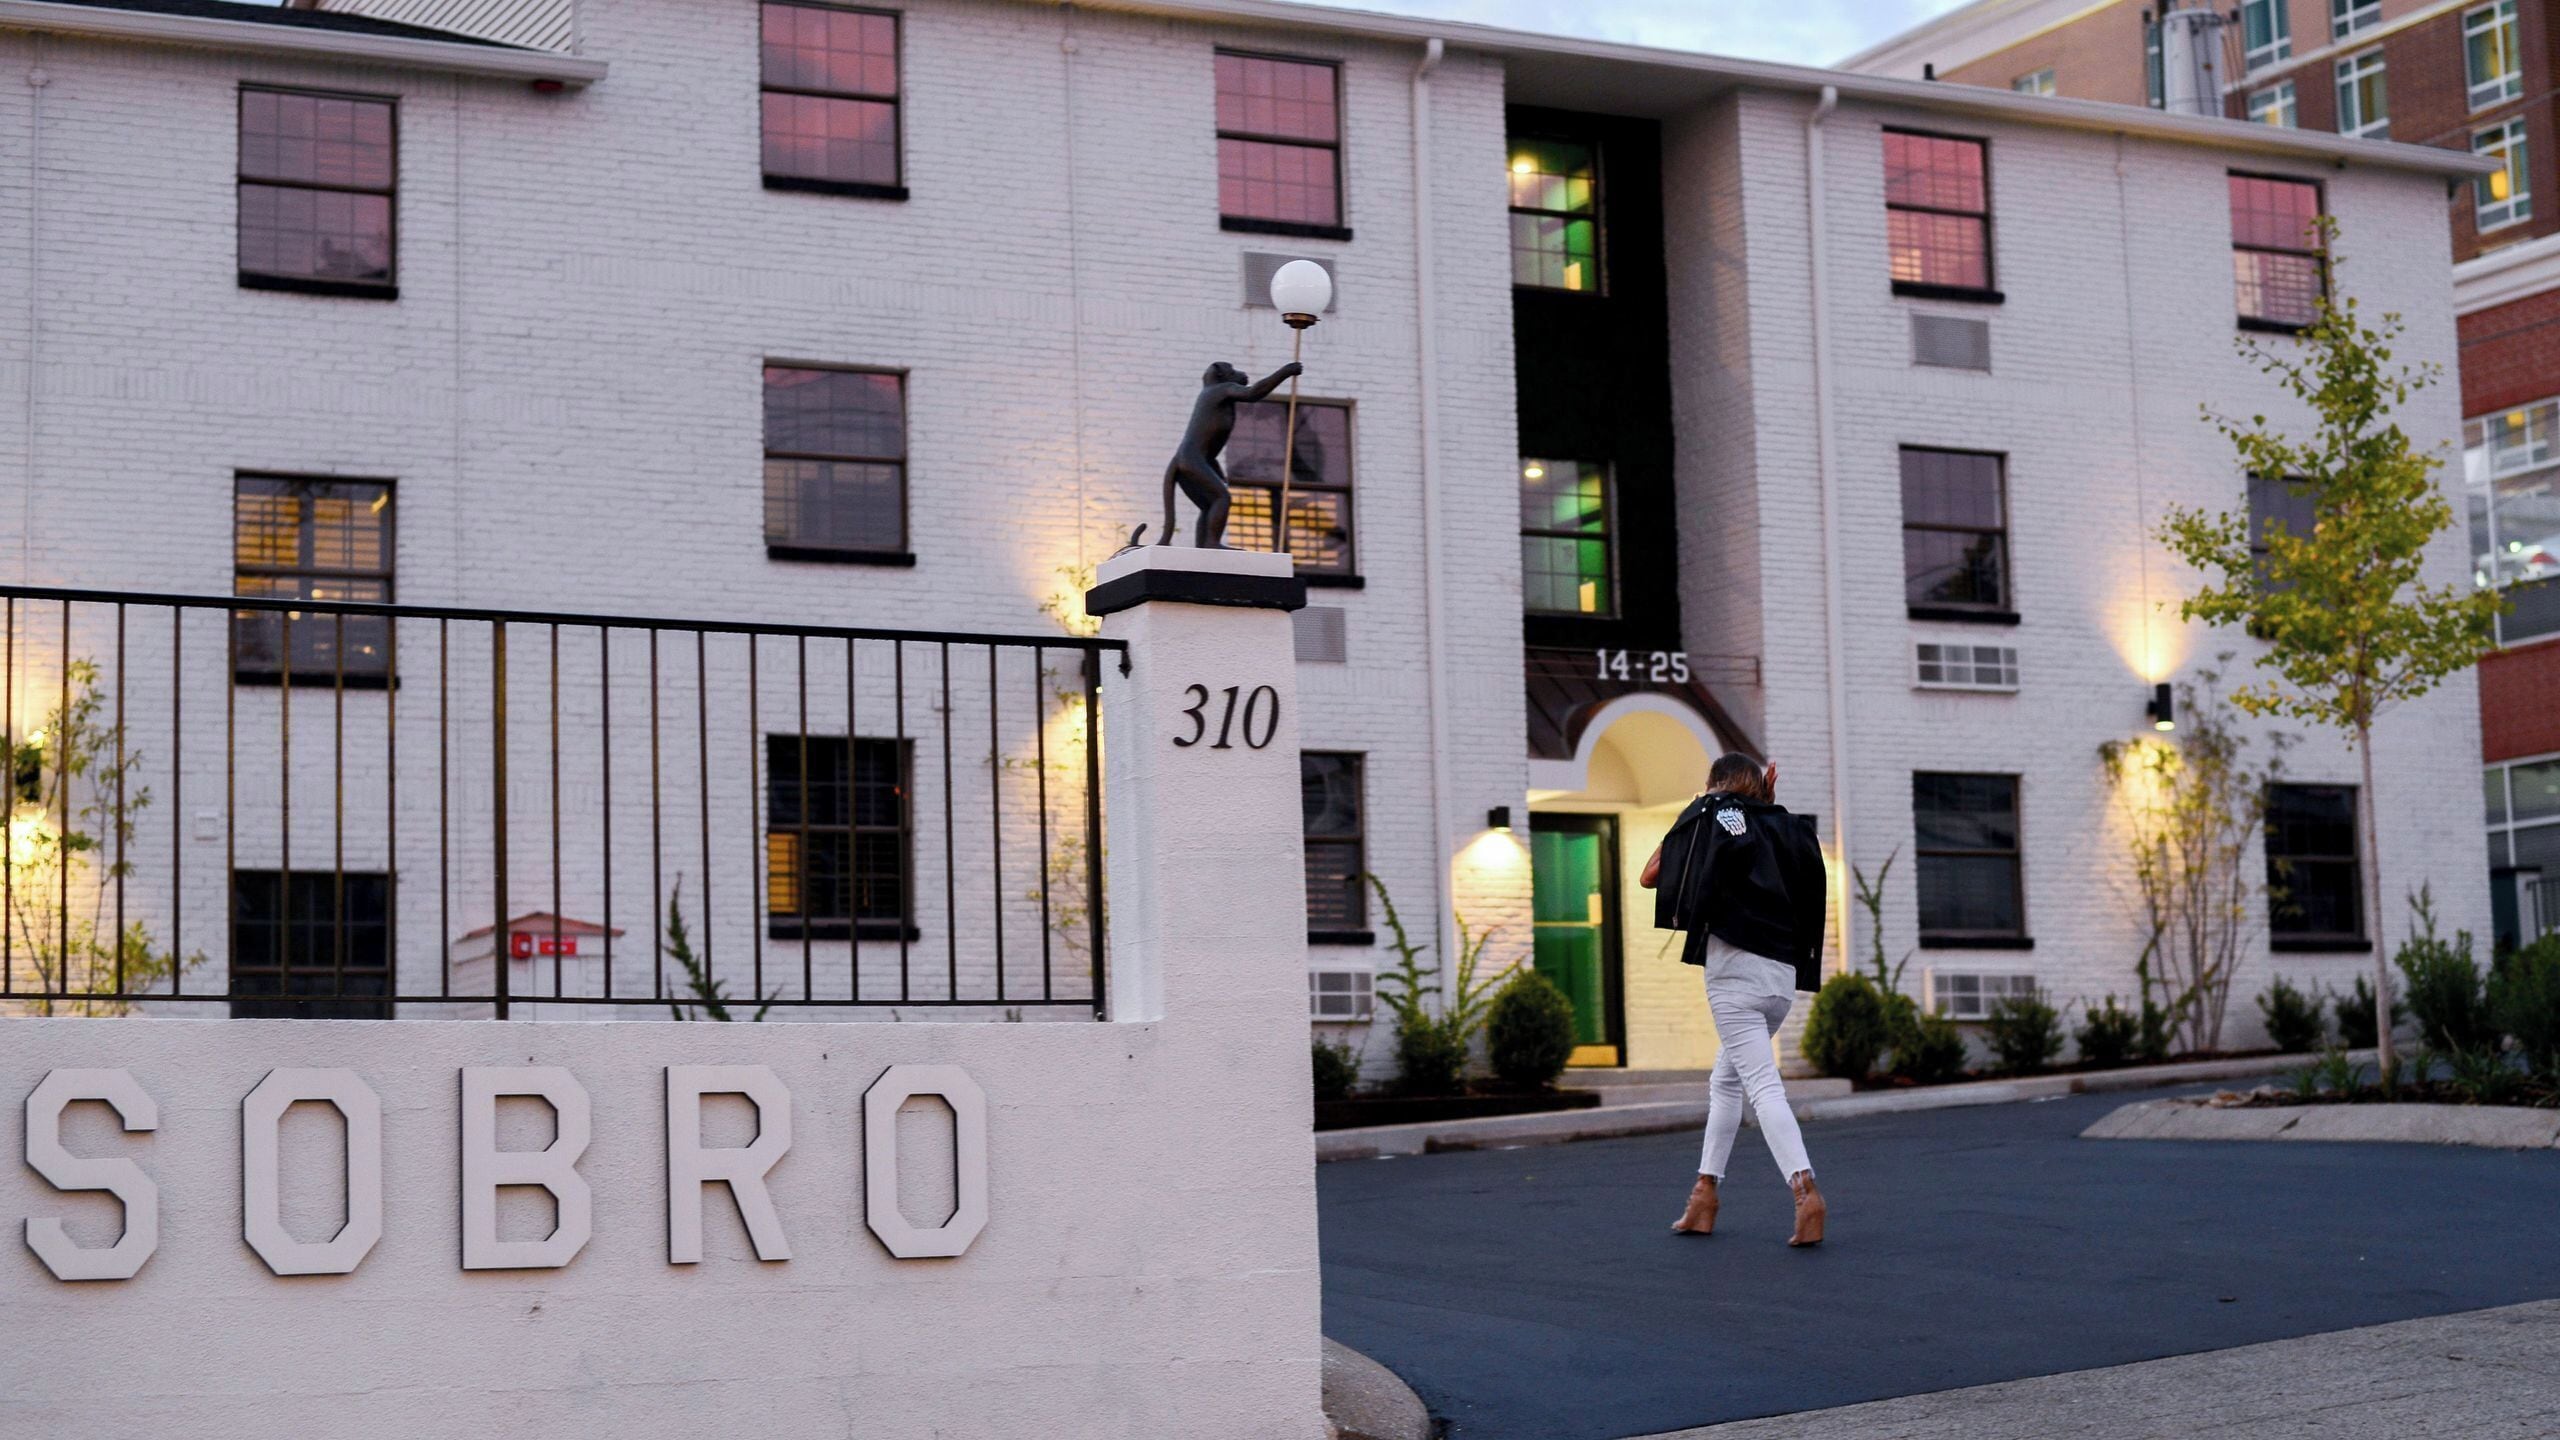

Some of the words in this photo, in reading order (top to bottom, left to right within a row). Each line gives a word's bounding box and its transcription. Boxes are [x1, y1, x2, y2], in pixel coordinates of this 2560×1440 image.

[1596, 648, 1690, 684] 14-25
[1172, 683, 1280, 750] 310
[24, 1064, 990, 1281] SOBRO
